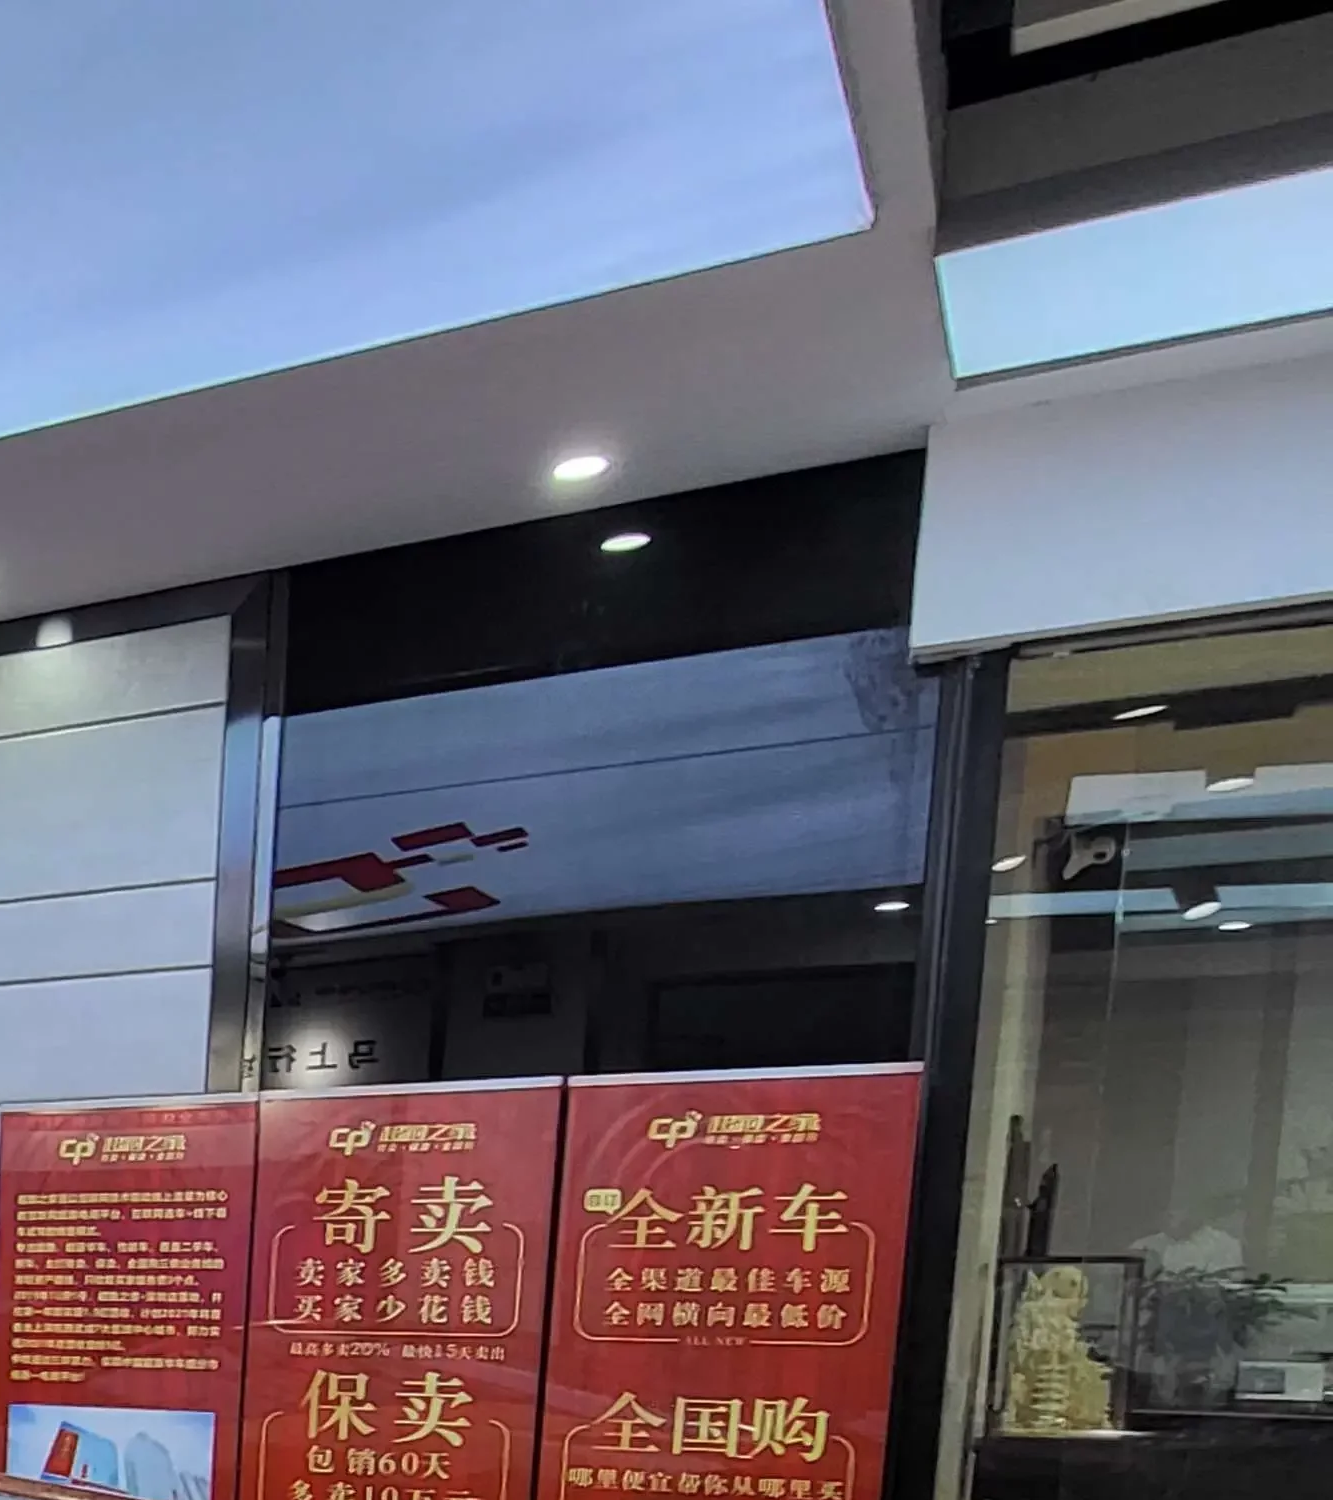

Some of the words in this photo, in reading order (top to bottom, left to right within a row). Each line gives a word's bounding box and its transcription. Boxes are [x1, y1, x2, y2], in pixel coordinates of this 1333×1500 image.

[312, 1175, 494, 1254] 寄卖
[605, 1182, 849, 1252] 全新车
[295, 1257, 495, 1288] 卖家多卖钱
[604, 1266, 851, 1295] 全渠道最佳车源
[293, 1294, 493, 1325] 买家少花钱
[601, 1300, 847, 1330] 全网横向最低价
[300, 1368, 473, 1447] 保卖
[589, 1391, 831, 1463] 全国购
[306, 1445, 451, 1480] 包销60天
